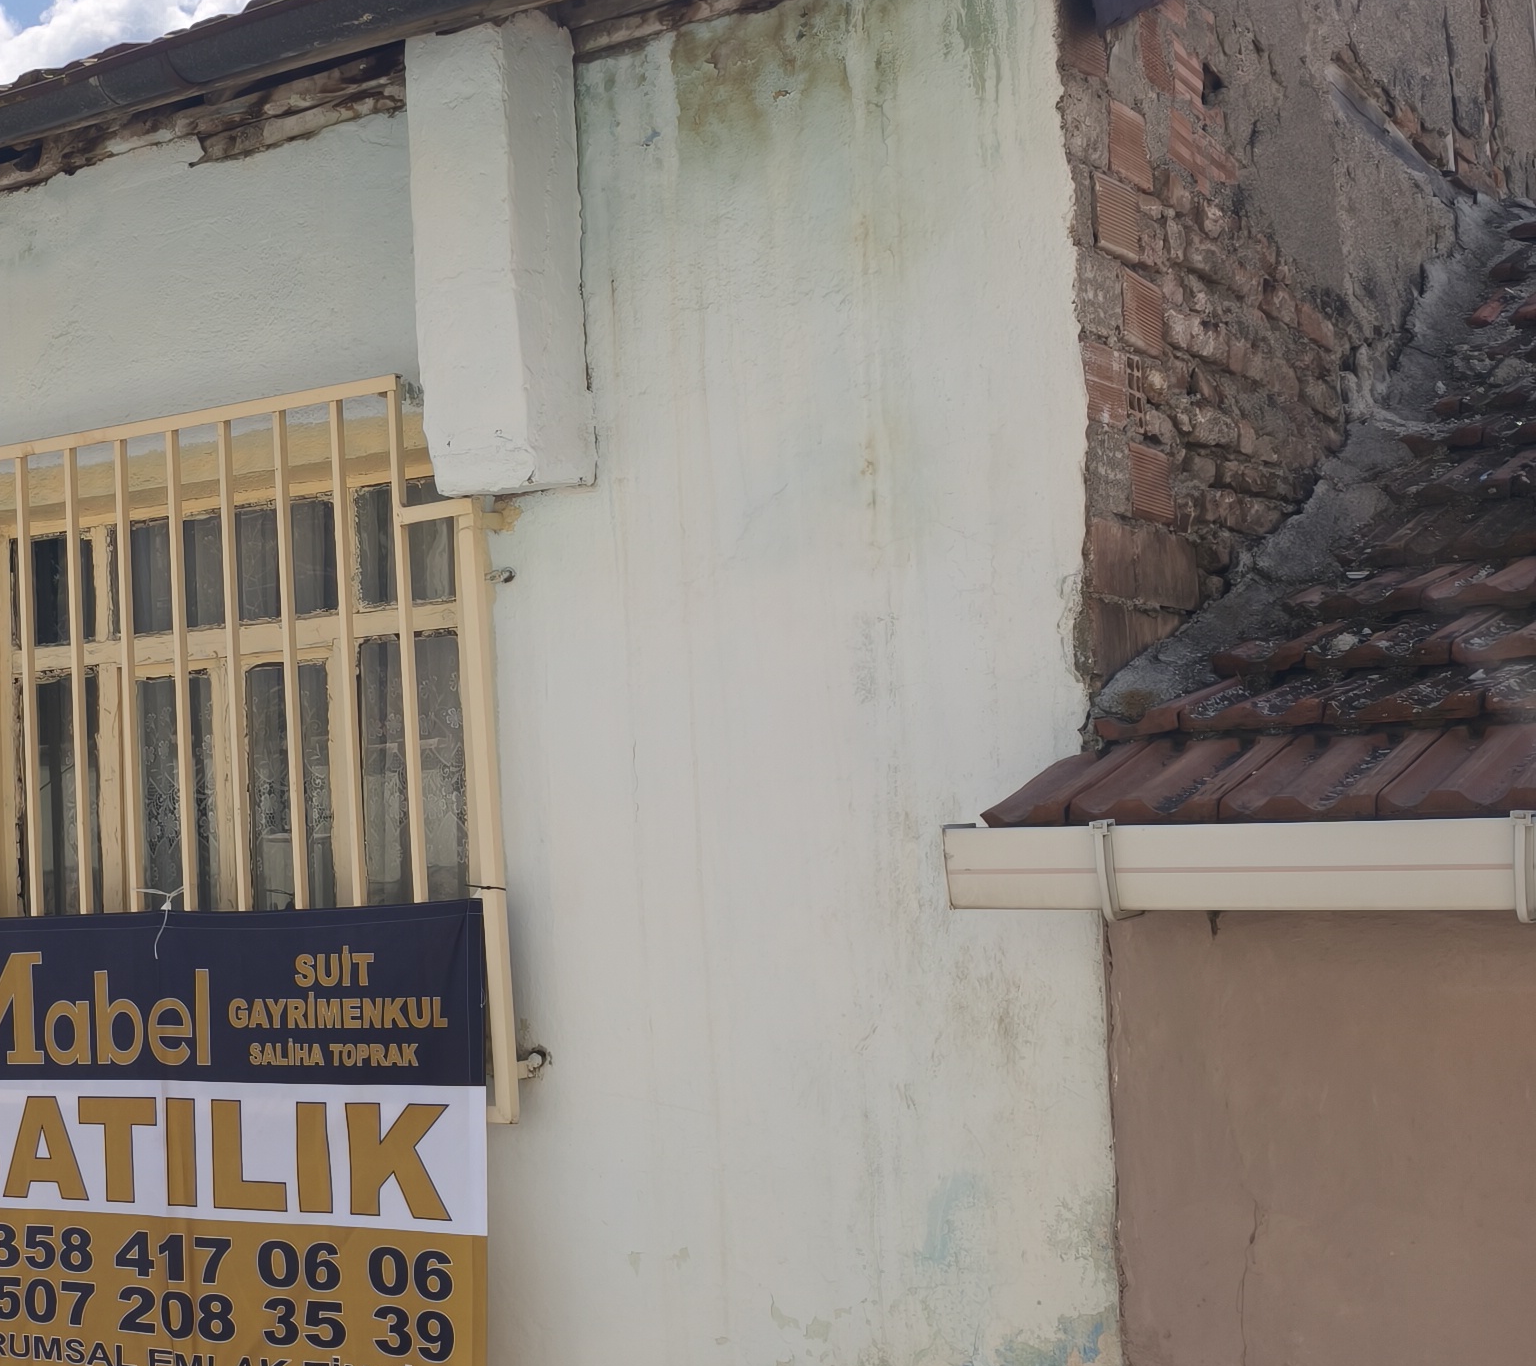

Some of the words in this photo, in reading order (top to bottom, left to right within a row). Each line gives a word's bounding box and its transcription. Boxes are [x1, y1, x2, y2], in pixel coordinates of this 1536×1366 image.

[294, 945, 375, 988] SUİT
[228, 991, 448, 1029] GAYRİMENKUL
[249, 1038, 325, 1067] SALİHA
[329, 1043, 420, 1067] TOPRAK
[114, 1230, 233, 1285] 417
[257, 1239, 342, 1292] 06
[367, 1245, 455, 1303] 06
[117, 1285, 237, 1343] 208
[263, 1296, 347, 1350] 35
[373, 1304, 456, 1363] 39
